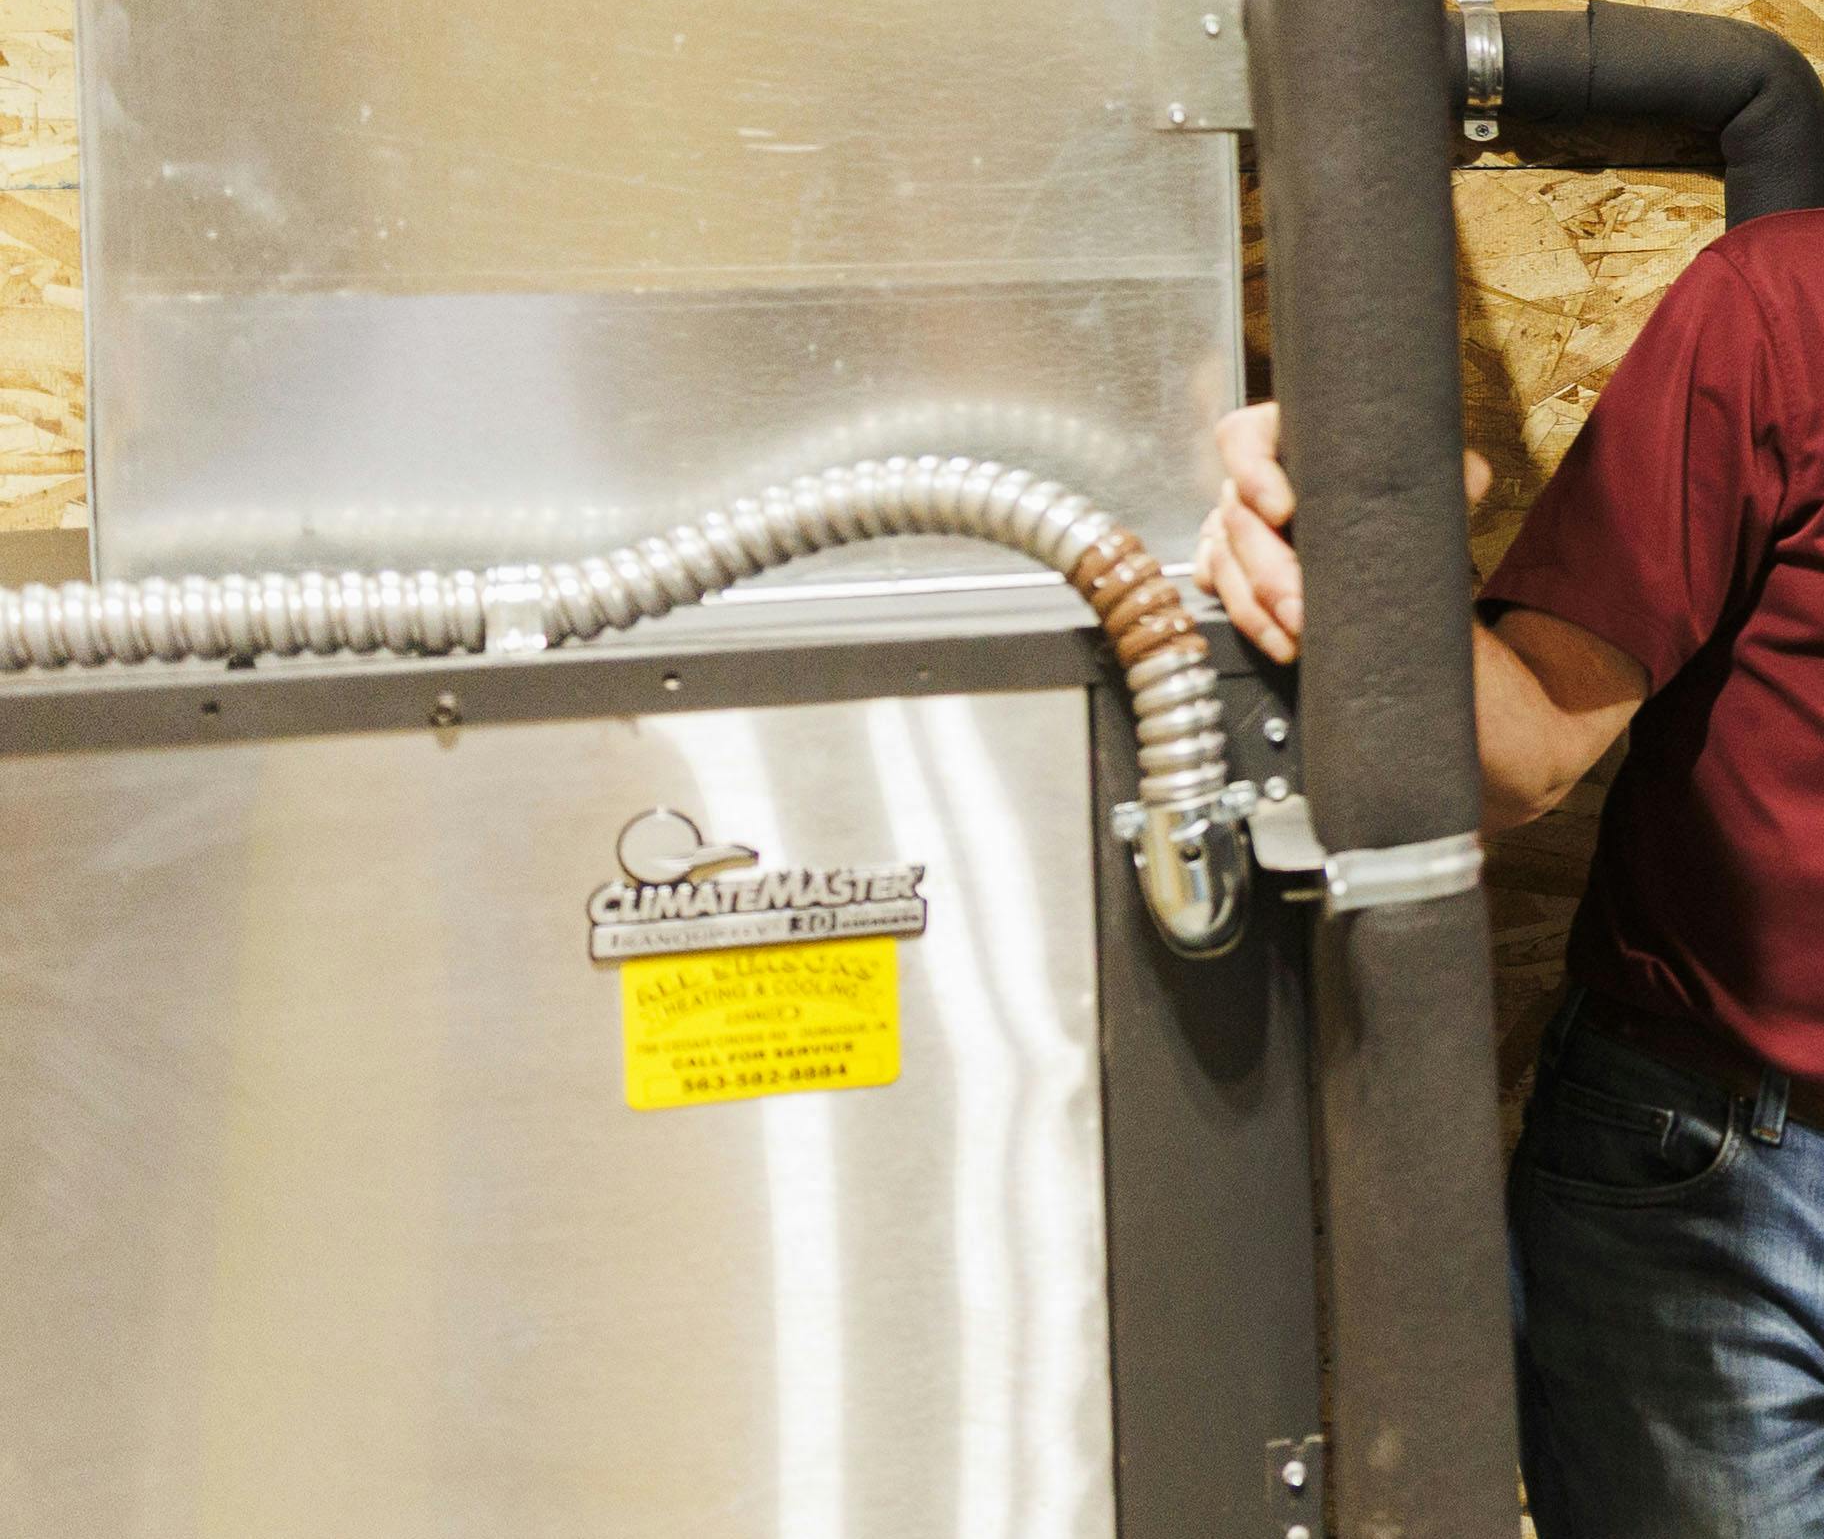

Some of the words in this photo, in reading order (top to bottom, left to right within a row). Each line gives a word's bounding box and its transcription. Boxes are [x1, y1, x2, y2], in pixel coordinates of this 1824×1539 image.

[636, 971, 701, 1007] ALL
[663, 983, 748, 1017] HEATING
[756, 981, 767, 995] &
[772, 981, 861, 1002] COOLING
[672, 1055, 720, 1070] CALL
[727, 1049, 767, 1063] FOR
[774, 1040, 854, 1060] SERVICE
